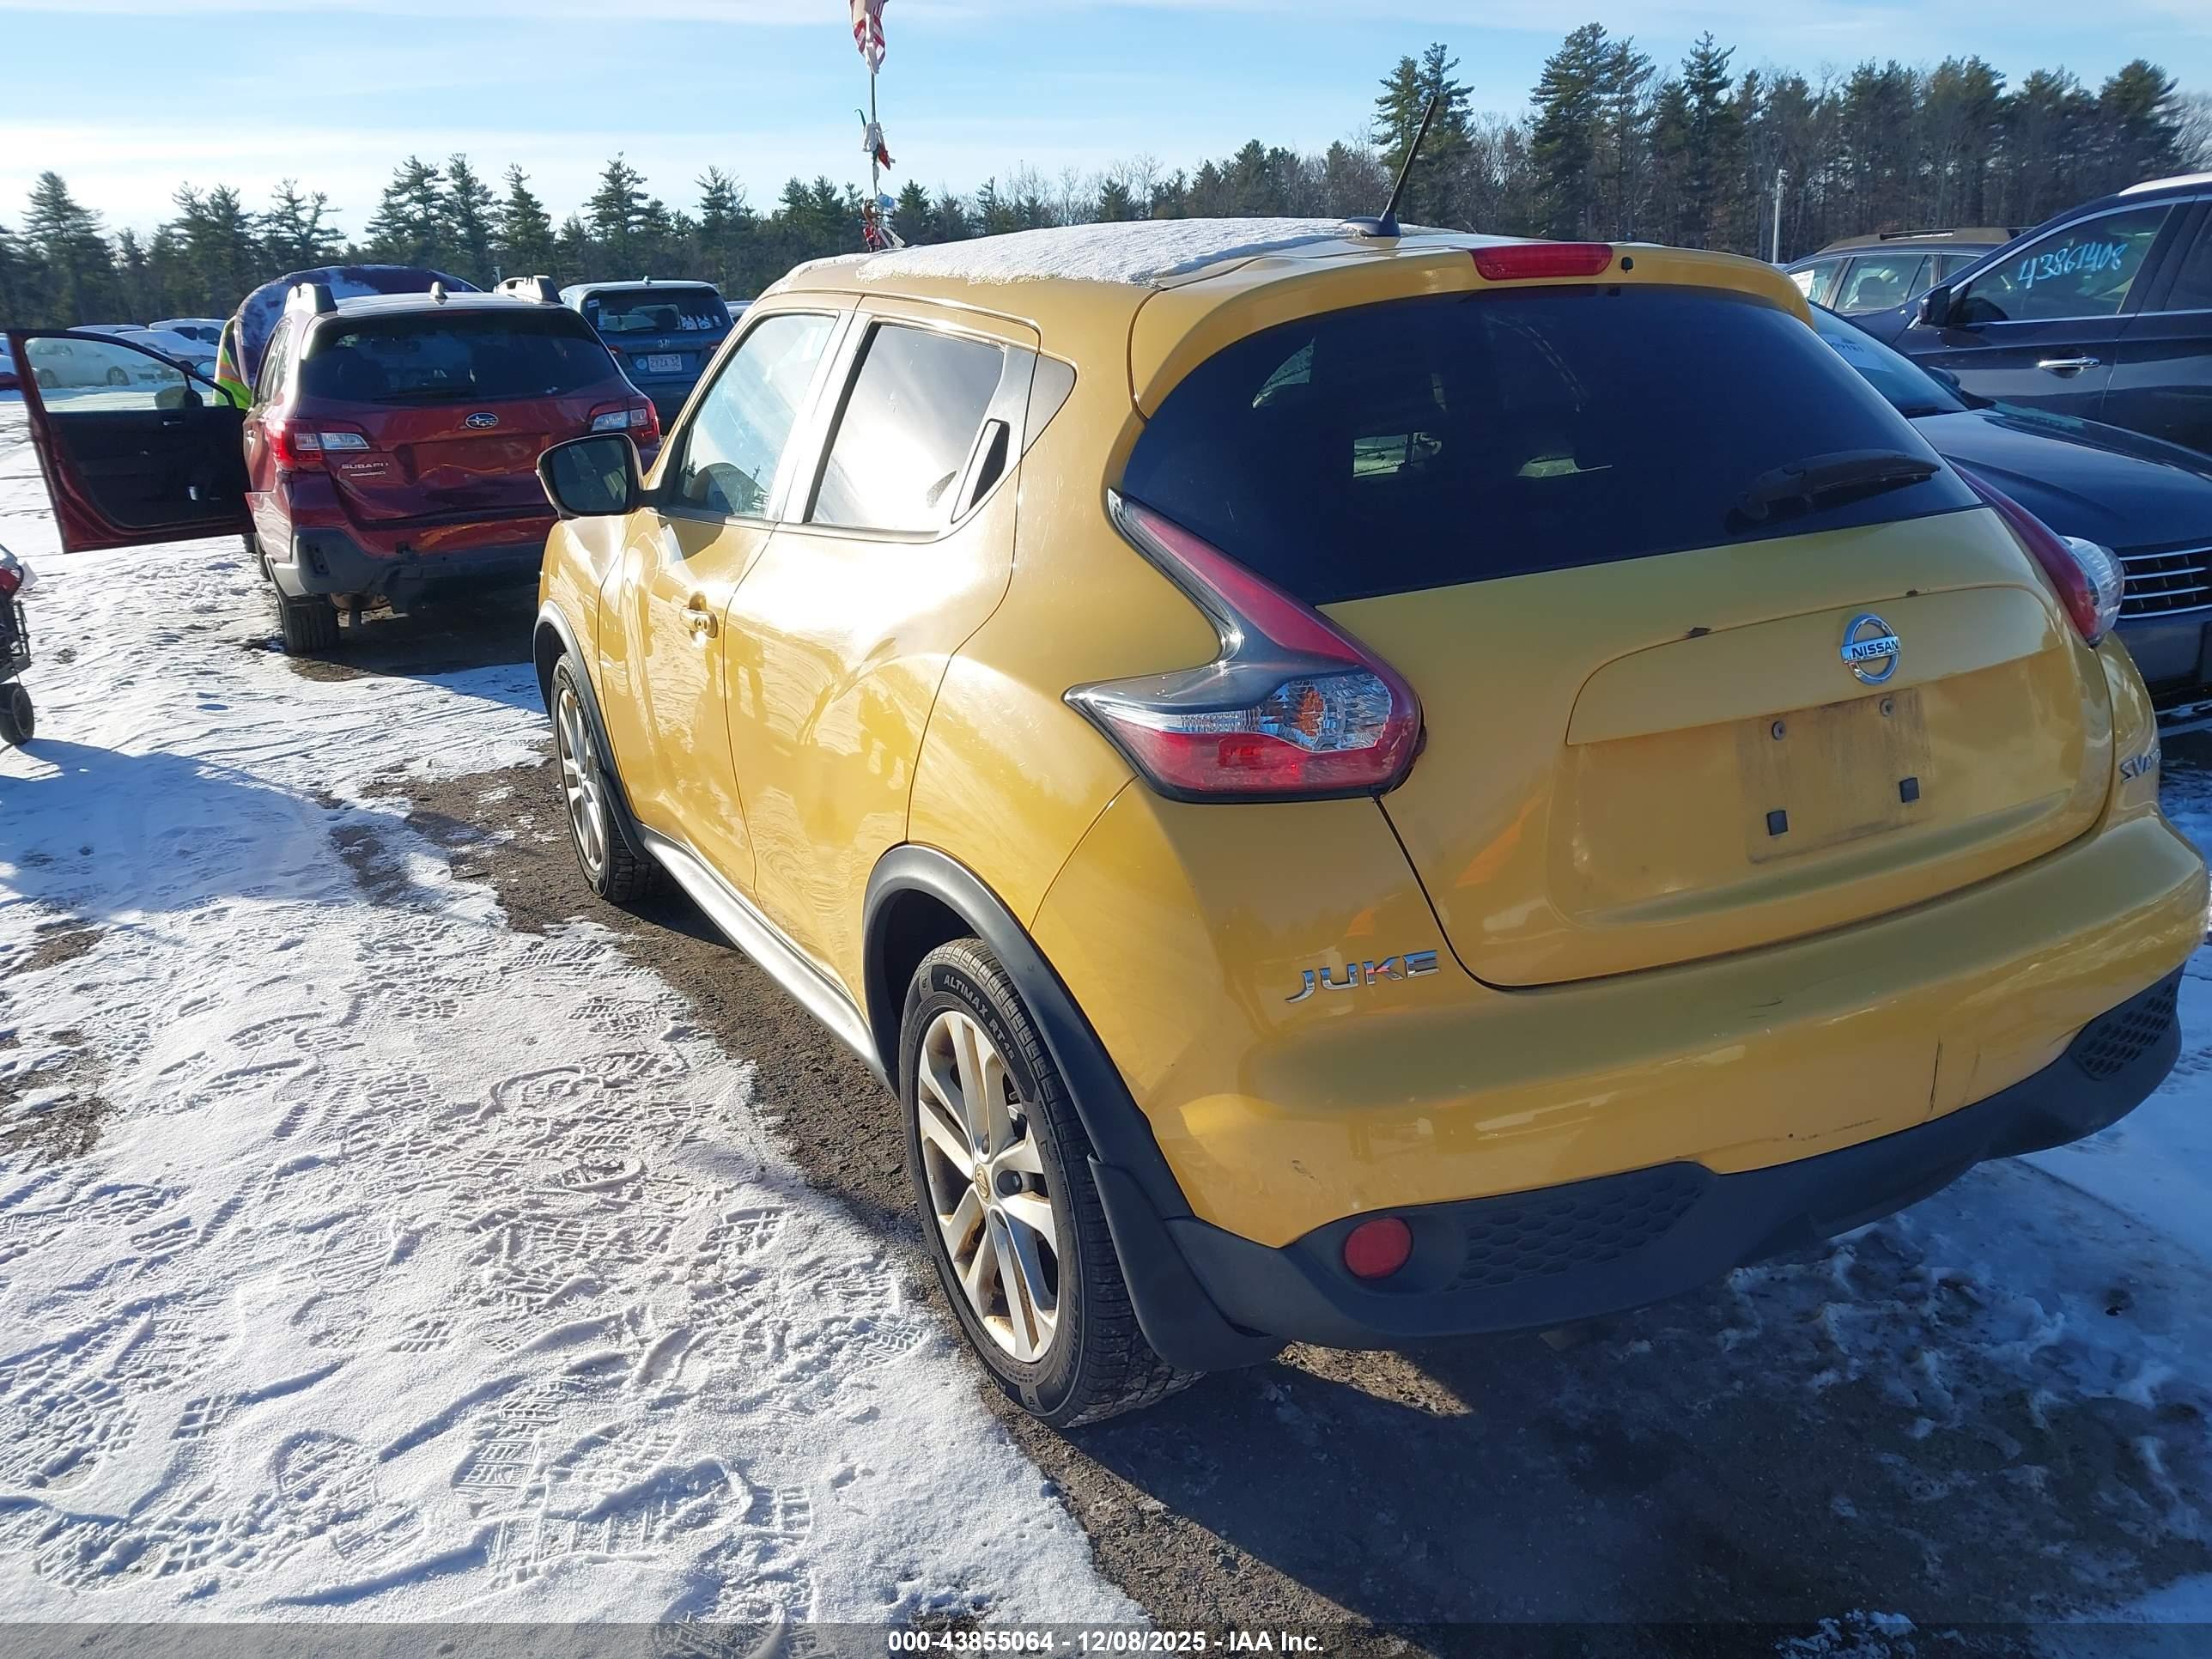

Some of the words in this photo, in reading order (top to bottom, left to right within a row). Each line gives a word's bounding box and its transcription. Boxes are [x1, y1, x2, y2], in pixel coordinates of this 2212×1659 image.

[2018, 241, 2129, 289] 43861408
[1851, 640, 1899, 658] NISSAN
[944, 974, 988, 1018] ALTIMAX
[1285, 950, 1439, 1003] JUKE
